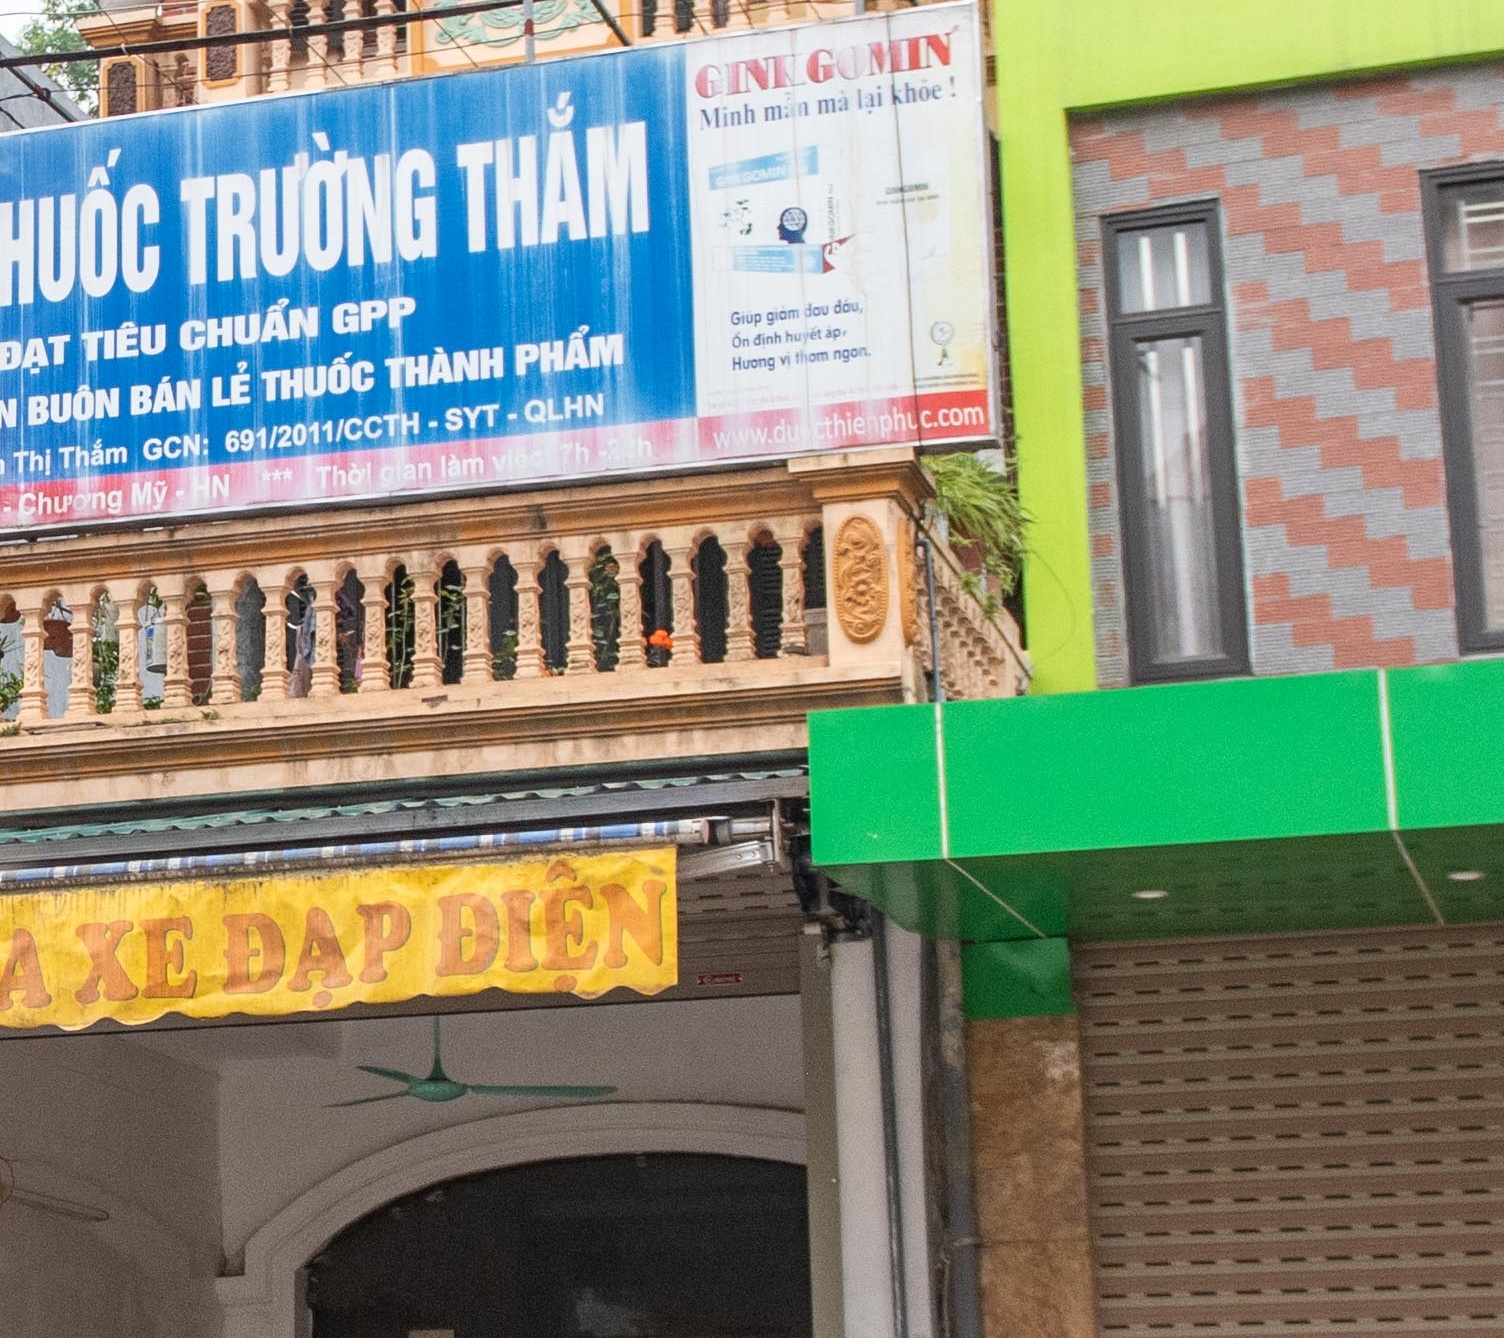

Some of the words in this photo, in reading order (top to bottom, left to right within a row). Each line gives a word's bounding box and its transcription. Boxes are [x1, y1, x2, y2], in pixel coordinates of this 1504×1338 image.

[700, 104, 755, 131] Minh
[857, 85, 882, 114] lại
[180, 132, 437, 286] TRƯỜNG
[456, 90, 651, 255] THẮM
[81, 323, 167, 362] TIÊU
[179, 297, 320, 351] CHUẨN
[332, 297, 417, 335] GPP
[28, 379, 121, 426] BUÔN
[130, 375, 201, 416] BÁN
[212, 361, 252, 407] LẺ
[261, 351, 375, 402] THUỐC
[385, 346, 504, 388] THÀNH
[515, 325, 625, 376] PHẨM
[14, 449, 51, 476] Thị
[59, 438, 128, 470] Thắm
[143, 433, 209, 461] GCN:
[225, 411, 420, 454] 691/2011/CCTH
[445, 404, 500, 432] SYT
[524, 393, 605, 424] QLHN
[18, 490, 123, 518] Chương
[131, 480, 168, 511] Mỹ
[194, 474, 230, 500] HN
[73, 915, 197, 1004] XE
[222, 901, 413, 1010] ĐẠP
[436, 861, 667, 994] ĐIỆN
